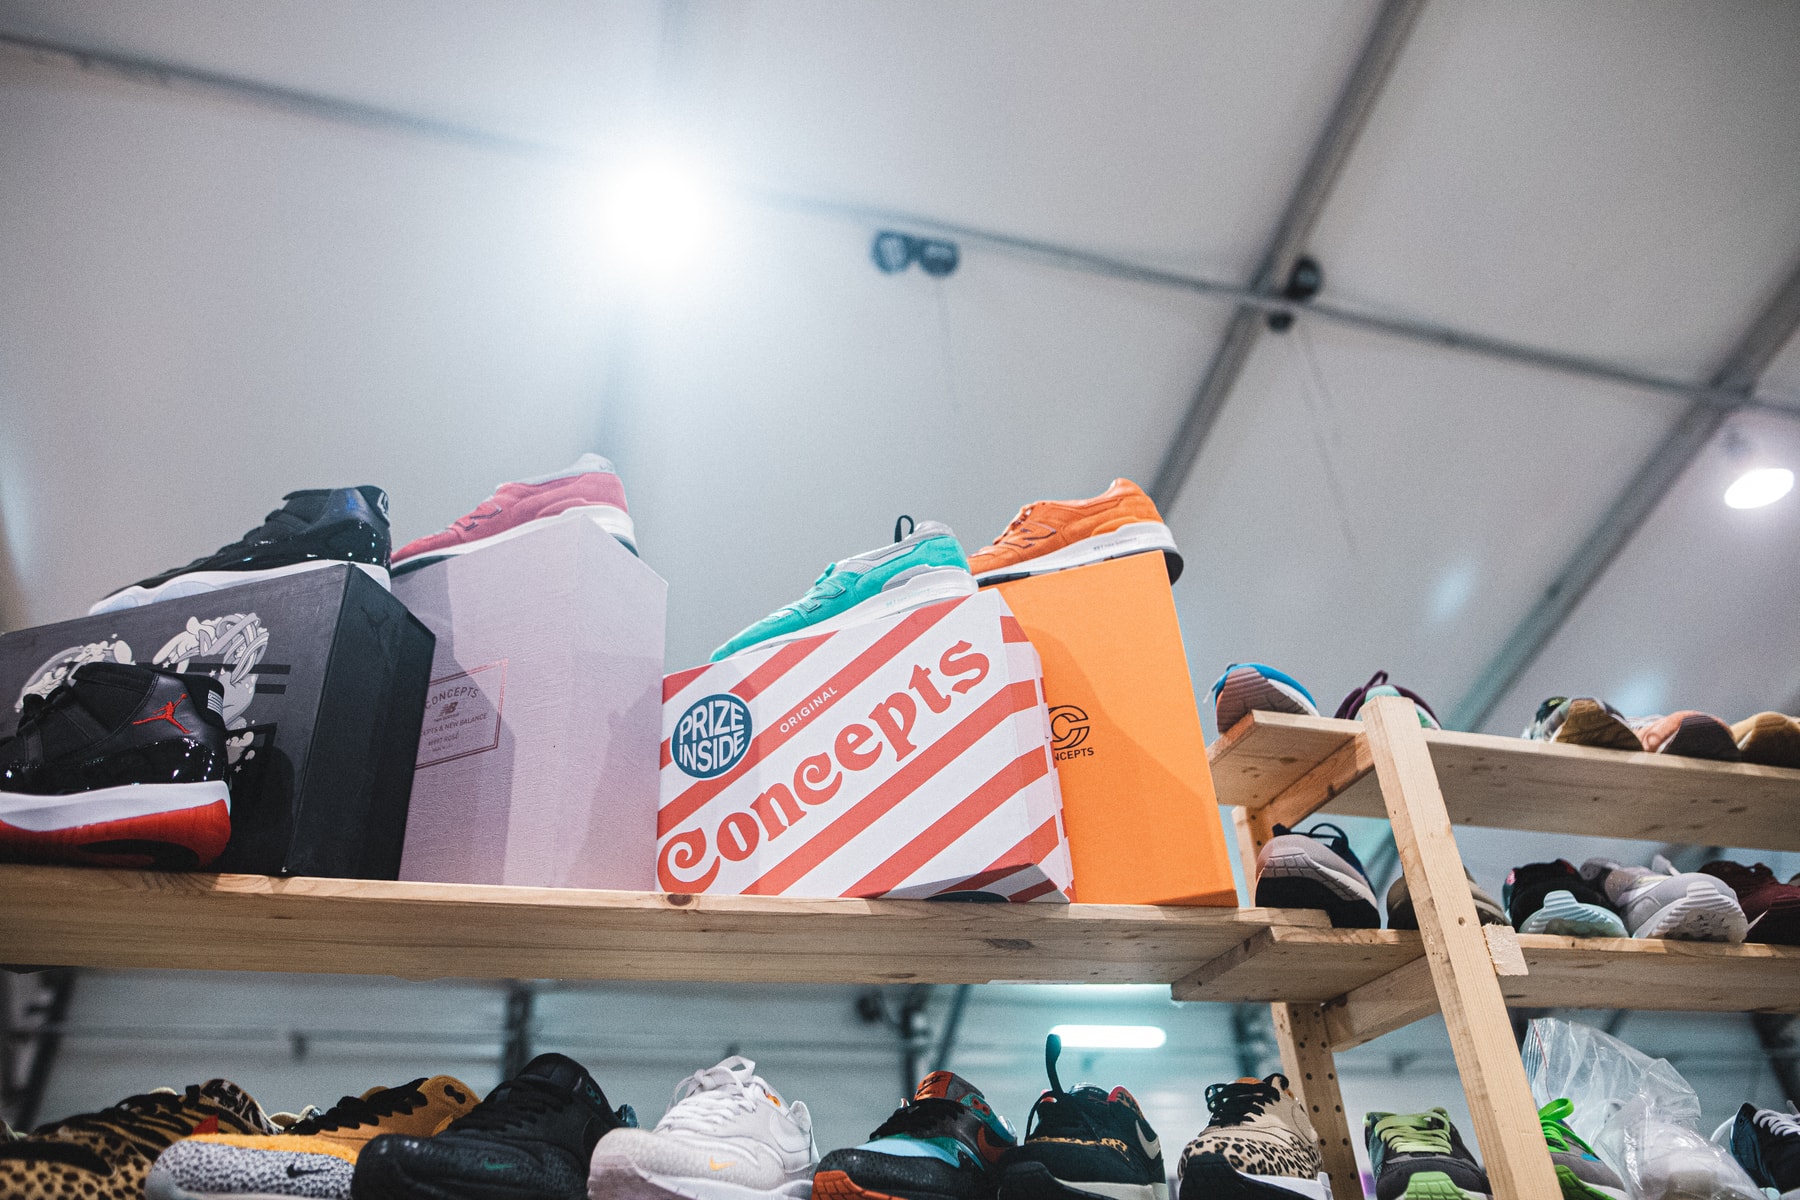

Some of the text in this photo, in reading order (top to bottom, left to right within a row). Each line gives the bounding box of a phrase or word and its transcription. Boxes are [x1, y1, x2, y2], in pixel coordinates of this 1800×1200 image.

[679, 700, 745, 744] PRIZE
[779, 687, 838, 734] ORIGINAL
[657, 639, 990, 893] Concepts
[679, 729, 745, 772] INSIDE
[1055, 746, 1095, 761] NCEPTS
